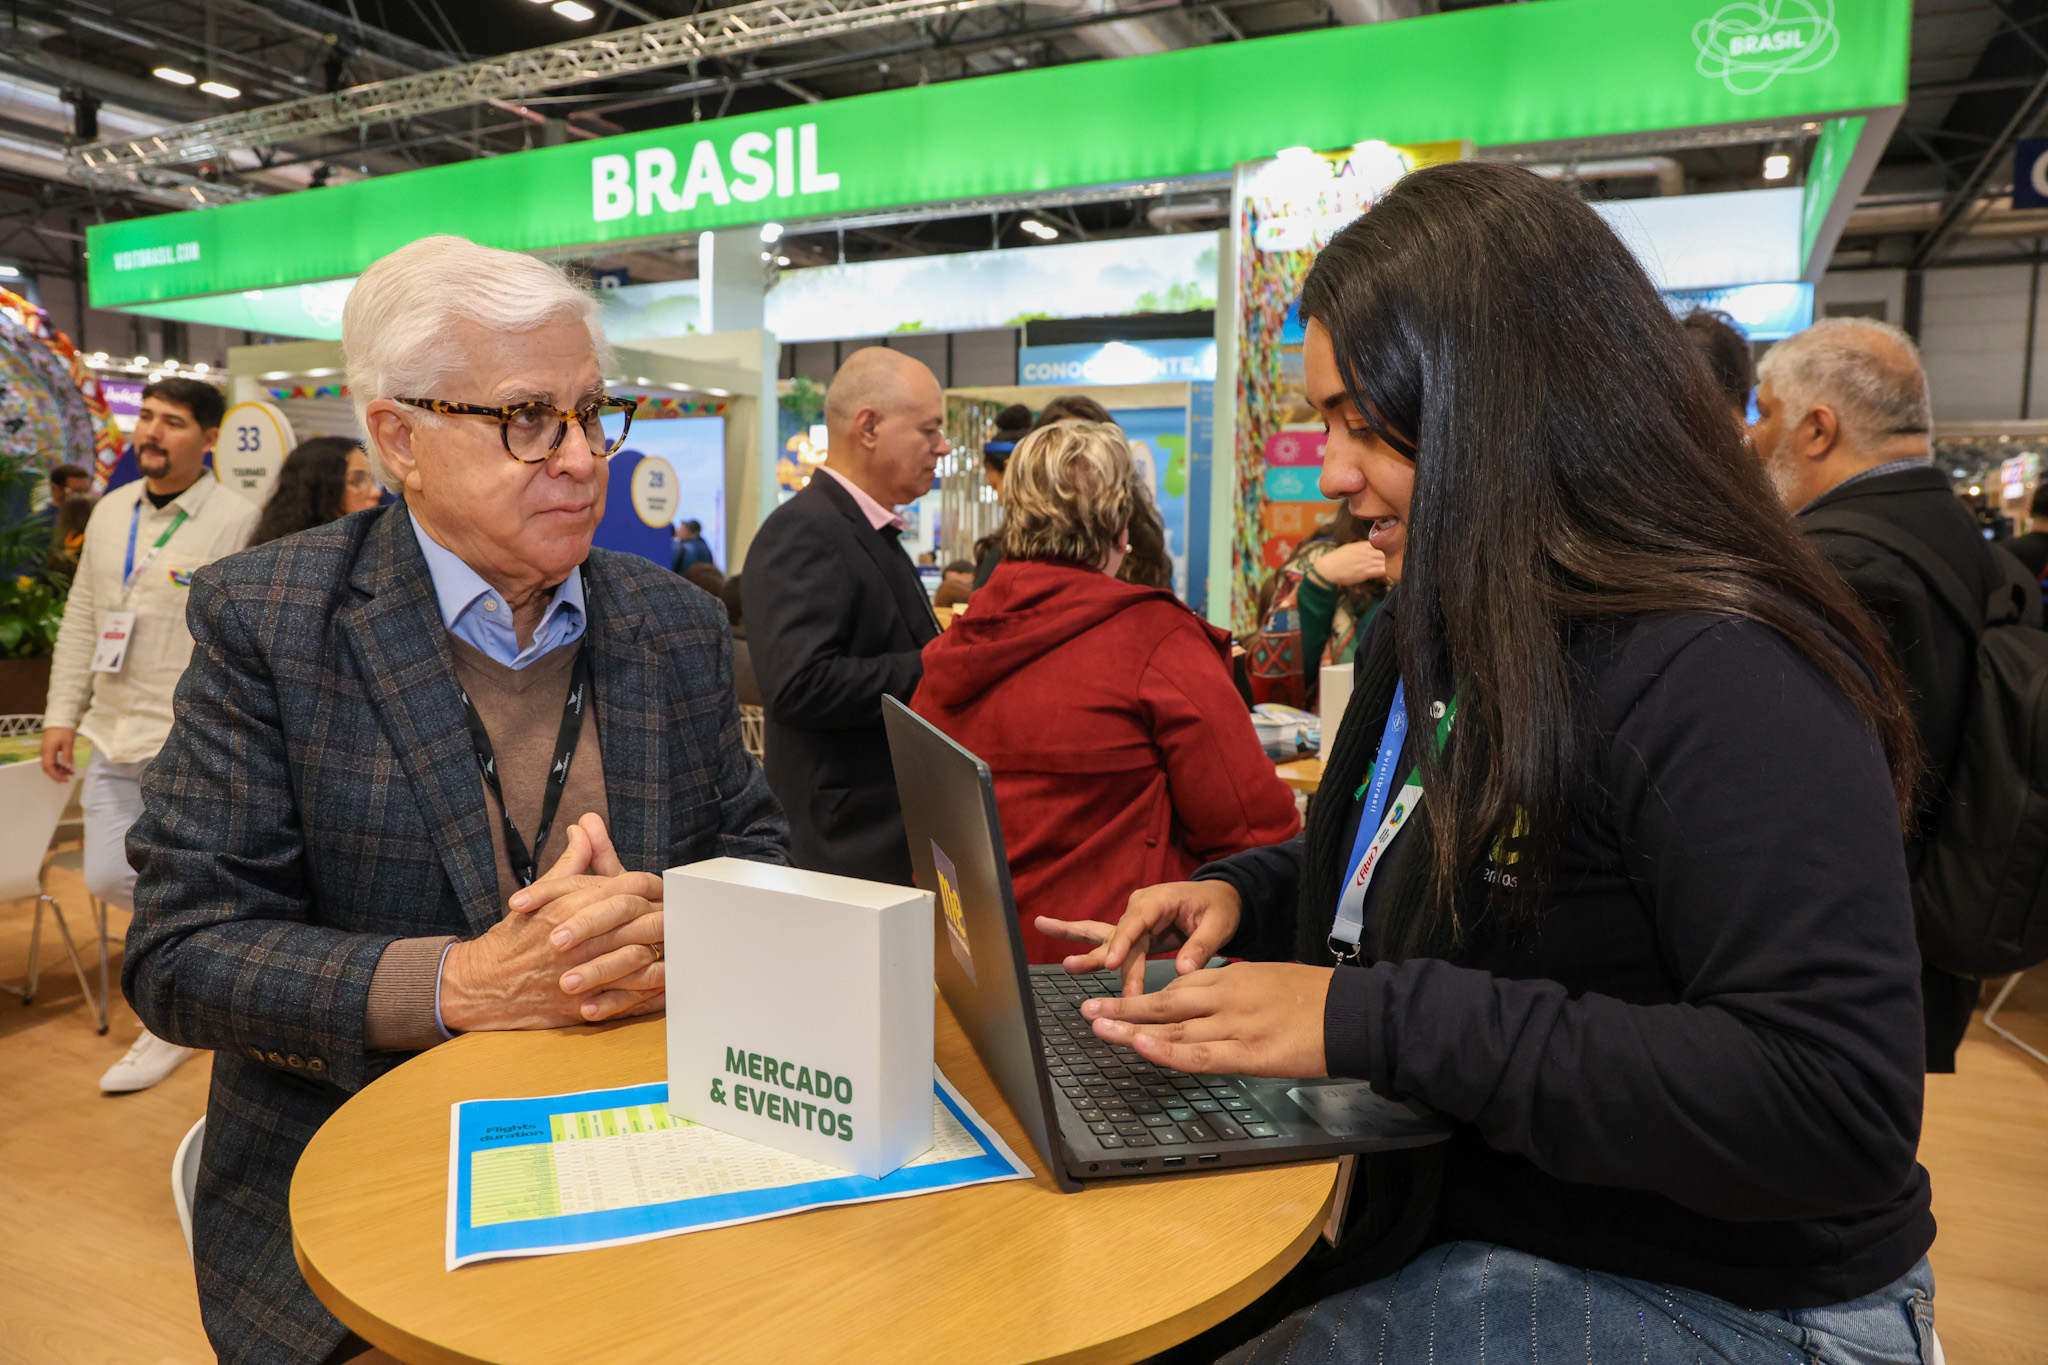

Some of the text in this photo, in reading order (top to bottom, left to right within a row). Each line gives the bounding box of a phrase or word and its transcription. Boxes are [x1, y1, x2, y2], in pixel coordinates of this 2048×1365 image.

[1729, 29, 1807, 57] BRASIL
[592, 123, 840, 222] BRASIL
[237, 426, 261, 452] 33
[1370, 749, 1392, 813] @visitbrasil
[1358, 849, 1375, 882] Fitur
[725, 1046, 853, 1105] MERCADO
[710, 1077, 727, 1106] &
[734, 1084, 853, 1142] EVENTOS
[480, 1131, 544, 1141] duration
[486, 1124, 537, 1134] Flights
